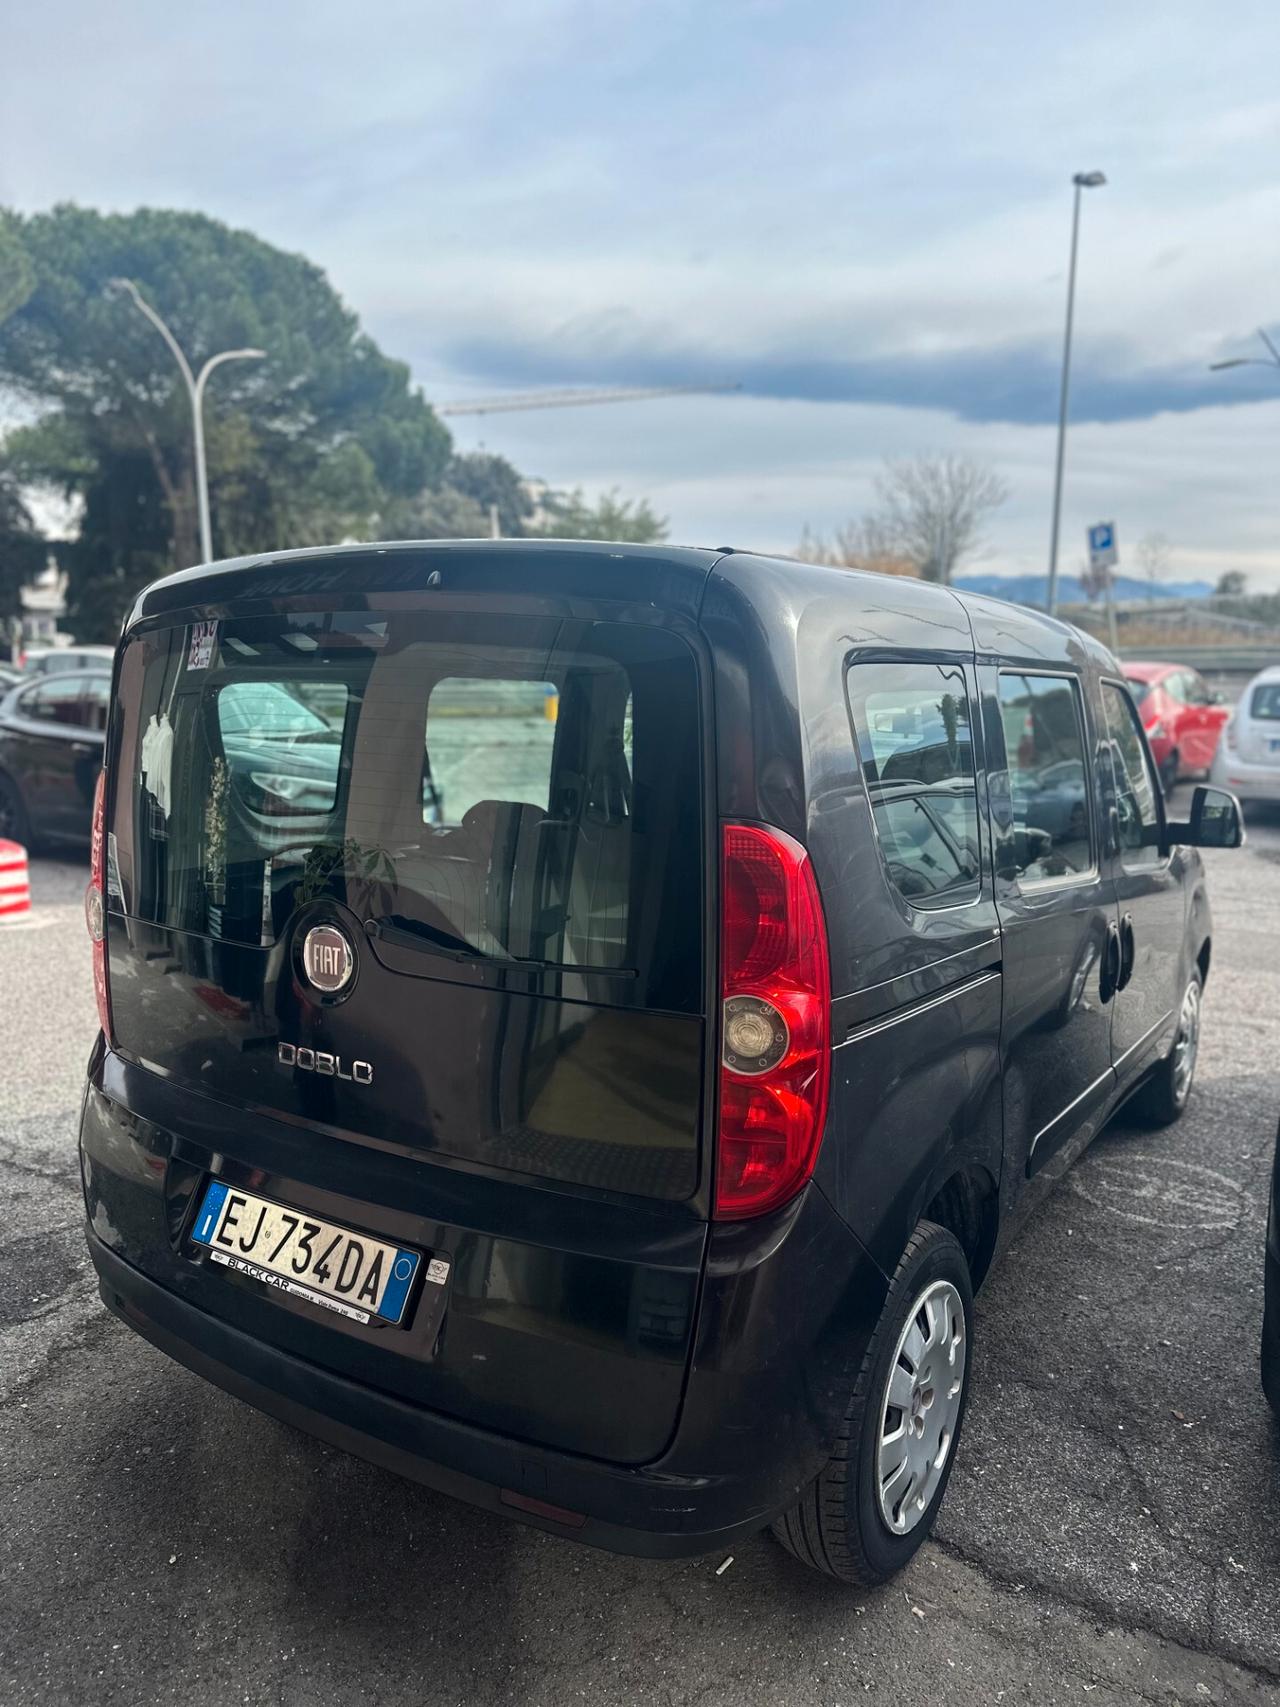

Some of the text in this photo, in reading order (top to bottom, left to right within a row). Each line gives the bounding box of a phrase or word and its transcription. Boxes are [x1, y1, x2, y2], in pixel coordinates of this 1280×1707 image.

[1095, 528, 1109, 547] P
[313, 943, 341, 976] FIAT
[278, 1041, 374, 1085] DOBLO
[227, 1257, 264, 1281] BLACK
[265, 1273, 290, 1291] CAR
